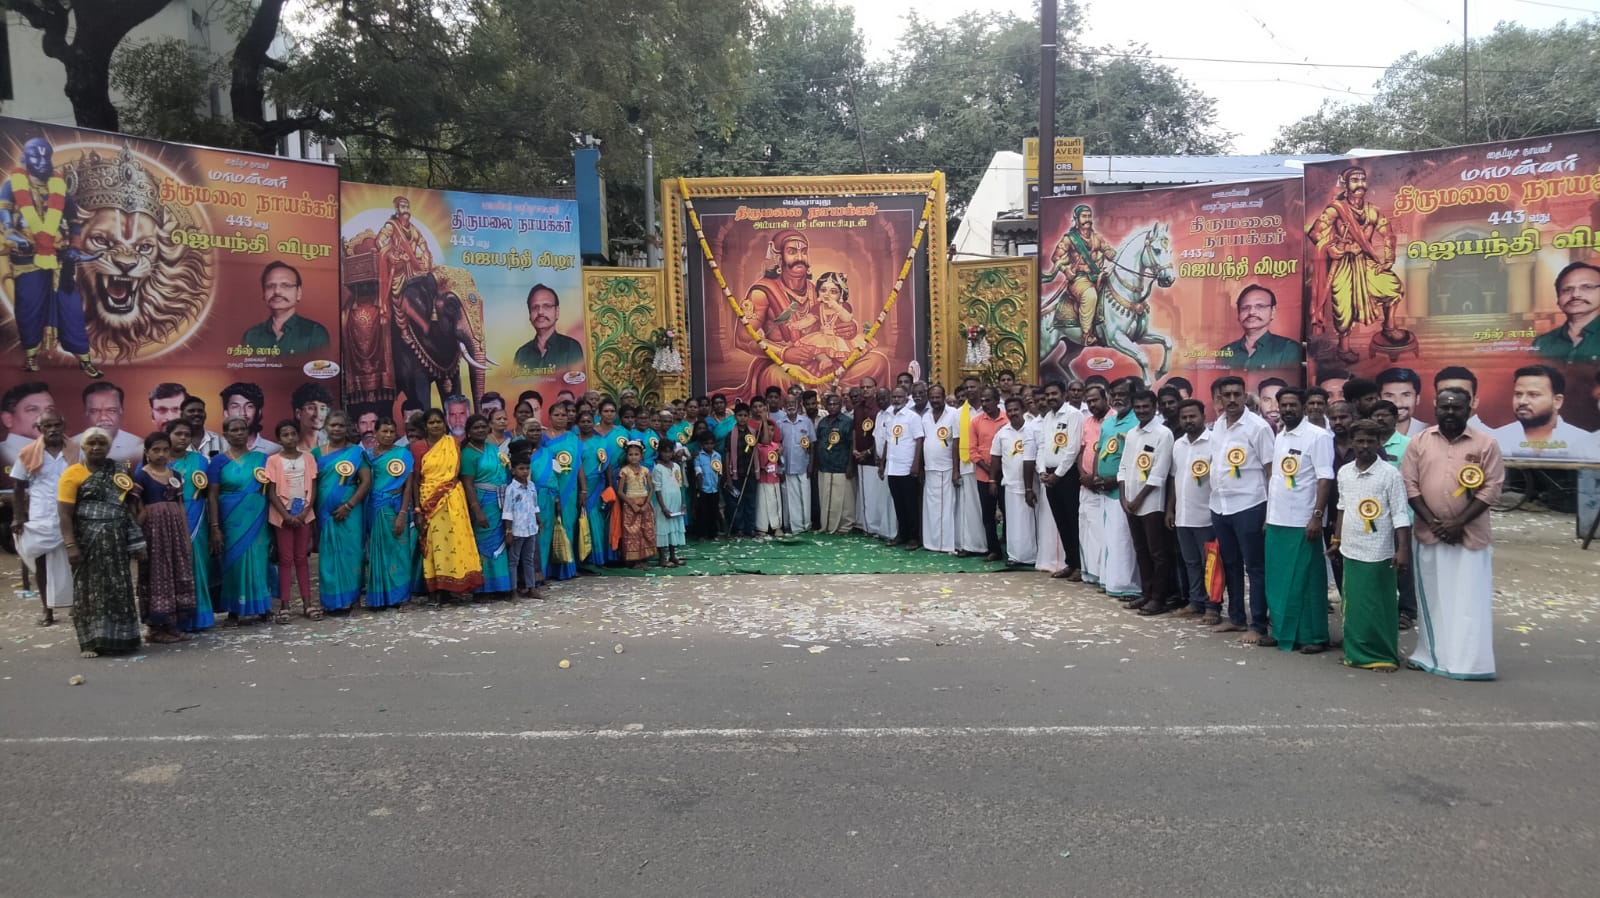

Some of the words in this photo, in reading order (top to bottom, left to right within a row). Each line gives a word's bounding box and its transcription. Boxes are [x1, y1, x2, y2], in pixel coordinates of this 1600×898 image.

[1055, 147, 1081, 155] AVERI
[1460, 153, 1581, 182] மாமன்னர்
[208, 169, 289, 189] மாமன்னர்
[159, 176, 247, 209] திருமலை
[256, 191, 338, 219] நாயக்கர்
[1393, 183, 1512, 217] திருமலை
[225, 214, 253, 228] 443
[451, 208, 513, 232] திருமலை
[518, 215, 573, 234] நாயக்கர்
[735, 205, 802, 221] திருமலை
[1487, 209, 1527, 225] 443
[1190, 214, 1283, 235] திருமலை
[171, 228, 270, 255] ஜெயந்தி
[277, 236, 333, 260] விழா
[450, 234, 475, 247] 443
[1204, 228, 1287, 249] நாயக்கர்
[1406, 228, 1542, 262] ஜெயந்தி
[462, 247, 533, 271] ஜெயந்தி
[537, 251, 576, 271] விழா
[1180, 248, 1202, 259] 443
[1180, 255, 1249, 280] ஜெயந்தி
[1253, 255, 1298, 279] விழா
